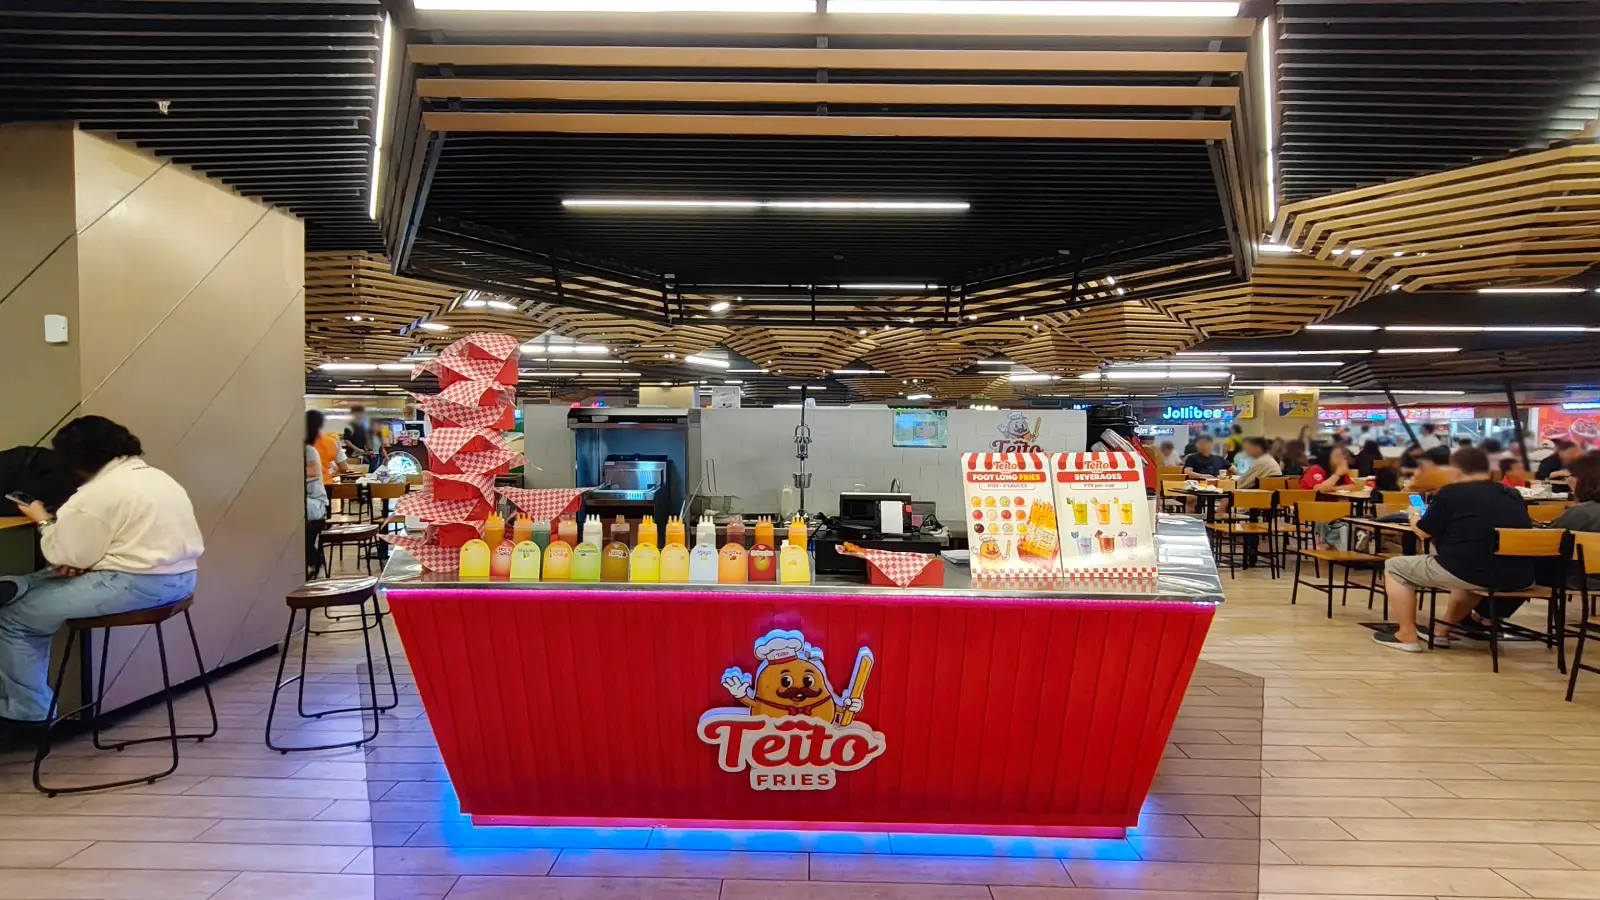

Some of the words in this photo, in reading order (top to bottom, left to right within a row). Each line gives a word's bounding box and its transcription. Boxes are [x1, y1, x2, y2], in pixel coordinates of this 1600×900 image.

[1163, 406, 1223, 419] Jollibee
[992, 440, 1044, 453] Teito
[993, 461, 1017, 470] Teito
[1084, 461, 1109, 470] Teito
[1074, 473, 1123, 481] BEVERAGES
[704, 719, 880, 768] Teito
[756, 773, 830, 786] FRIES
